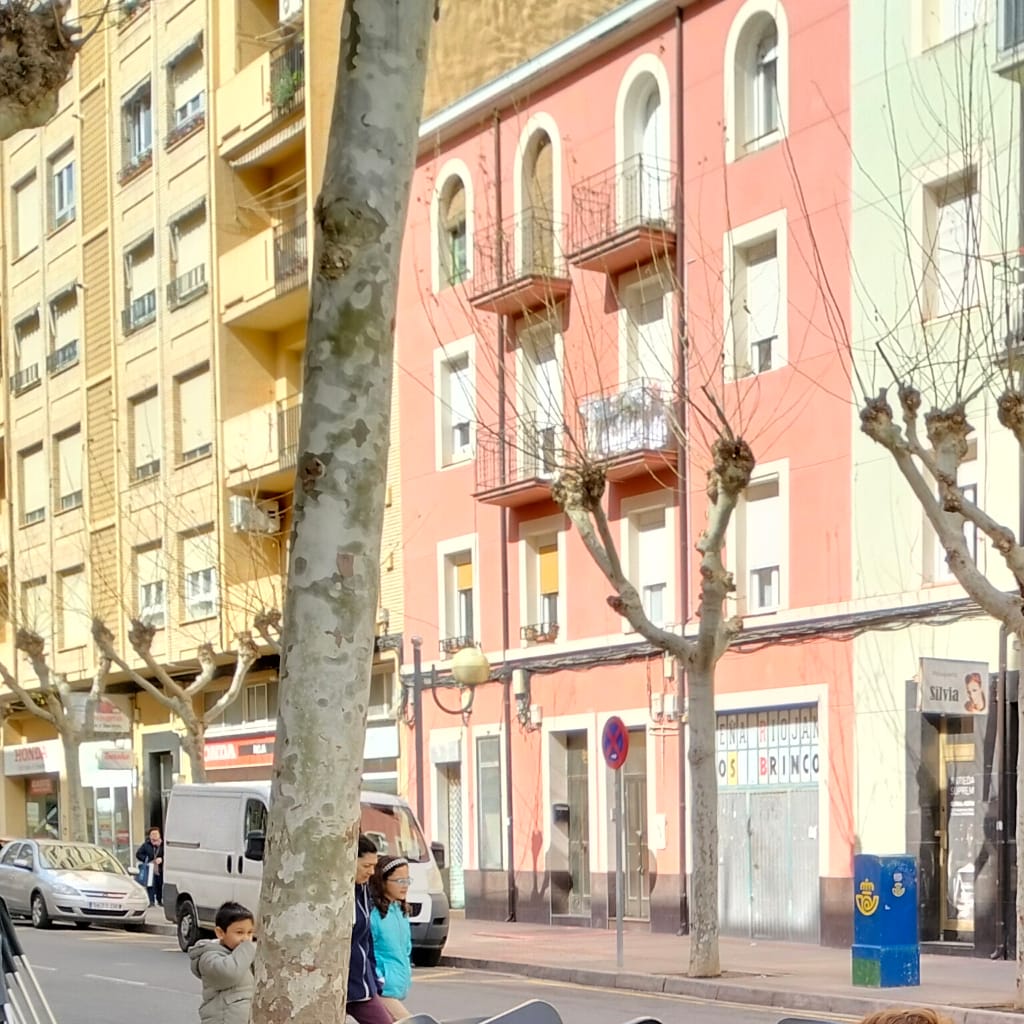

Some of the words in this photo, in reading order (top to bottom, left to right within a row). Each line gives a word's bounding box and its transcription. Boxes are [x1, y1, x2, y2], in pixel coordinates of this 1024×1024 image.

[929, 686, 959, 702] Silvia
[719, 718, 747, 745] EÑA
[760, 715, 819, 743] RIOJAN
[204, 743, 237, 762] ONDA
[718, 758, 736, 778] OS
[760, 753, 819, 776] BRINCO
